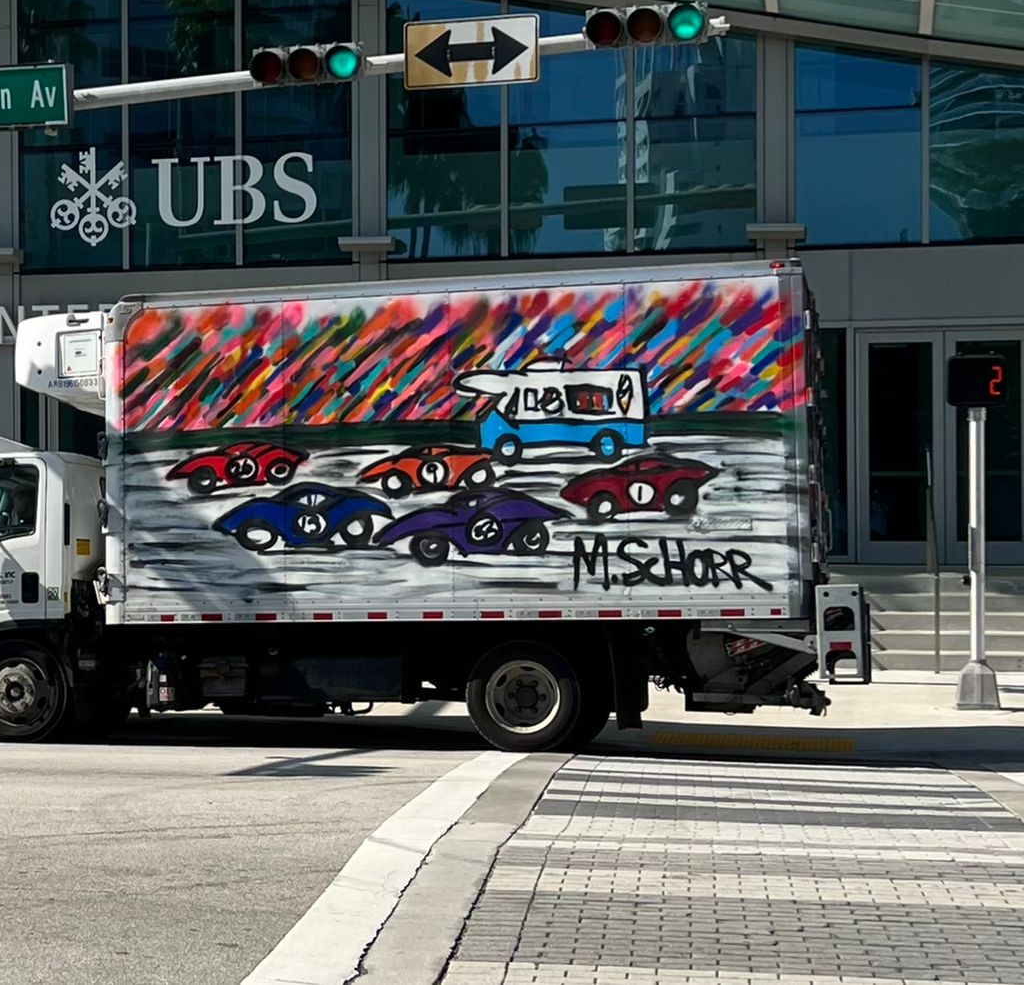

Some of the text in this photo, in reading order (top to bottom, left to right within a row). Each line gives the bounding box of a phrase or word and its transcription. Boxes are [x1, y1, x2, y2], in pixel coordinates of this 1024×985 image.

[30, 80, 57, 109] Av
[151, 152, 318, 227] UBS
[988, 365, 1003, 396] 2
